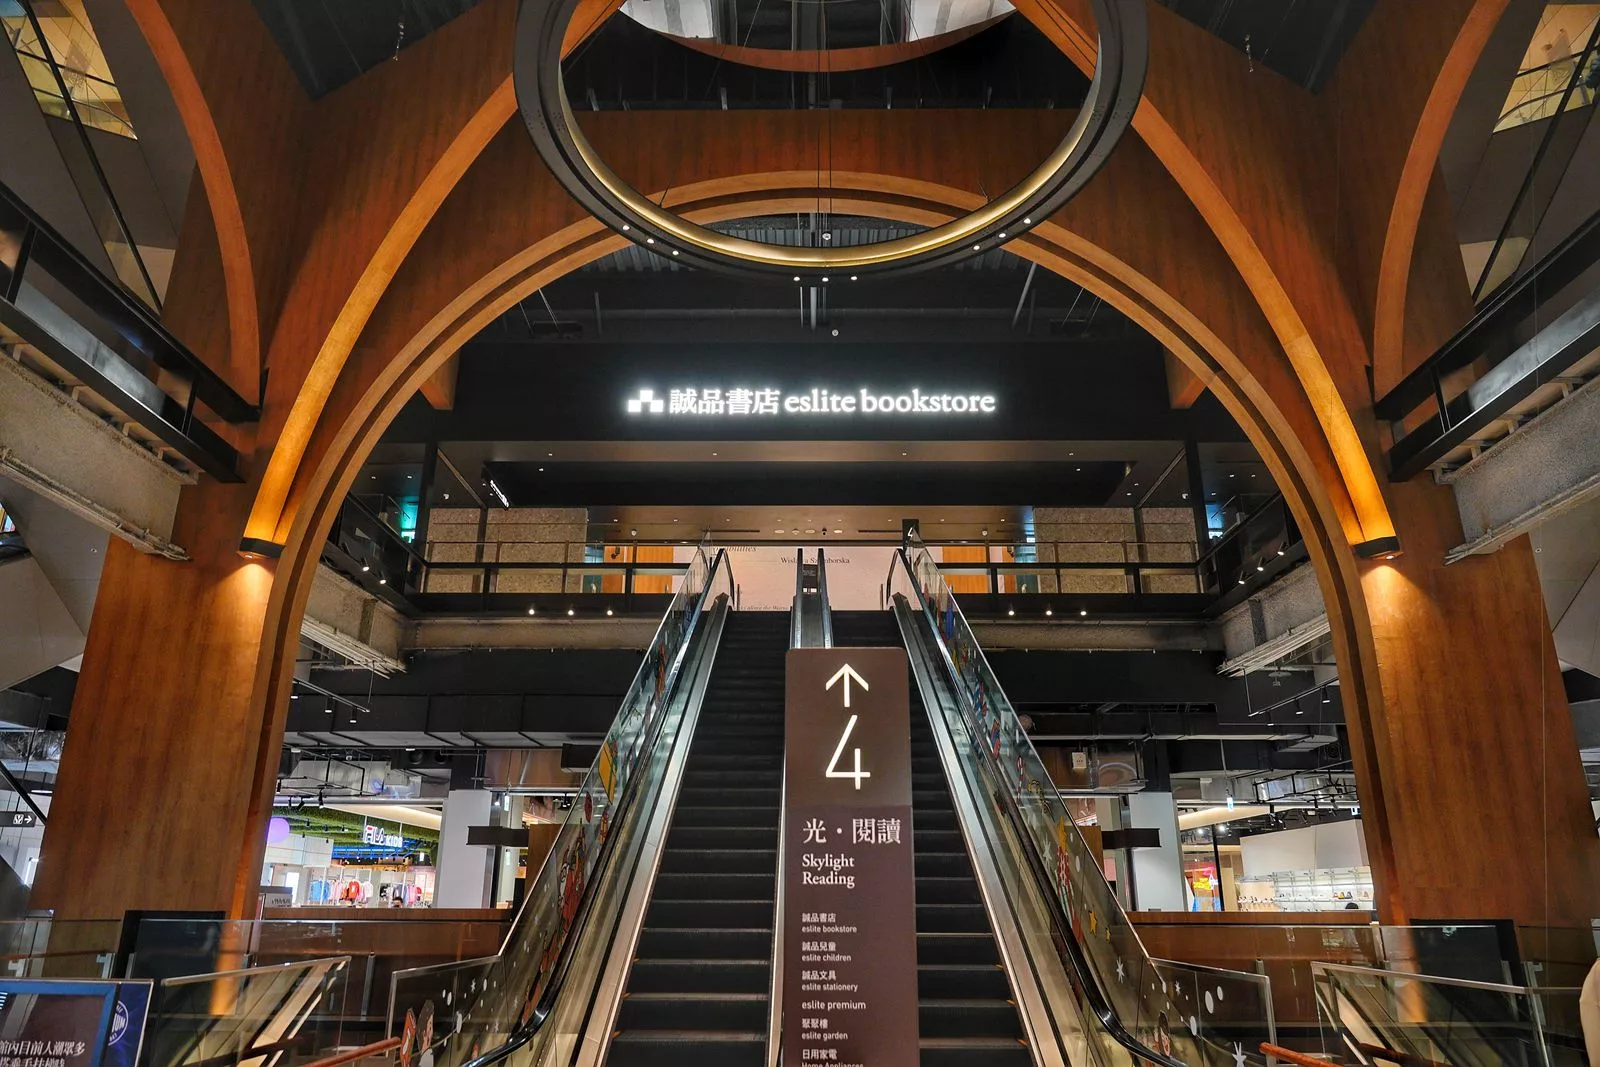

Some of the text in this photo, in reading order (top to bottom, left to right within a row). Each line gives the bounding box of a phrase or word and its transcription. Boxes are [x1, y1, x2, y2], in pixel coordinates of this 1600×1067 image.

[670, 388, 996, 415] 誠品書店 eslite bookstore
[825, 714, 871, 790] 4
[802, 853, 855, 871] Skylight
[802, 870, 855, 889] Reading
[802, 912, 836, 923] 誠品書店
[801, 924, 858, 933] eslite bookstore
[801, 953, 852, 962] eslite children
[801, 982, 859, 993] eslite stationery
[801, 1000, 867, 1012] eslite premium
[801, 1031, 849, 1042] eslite garden
